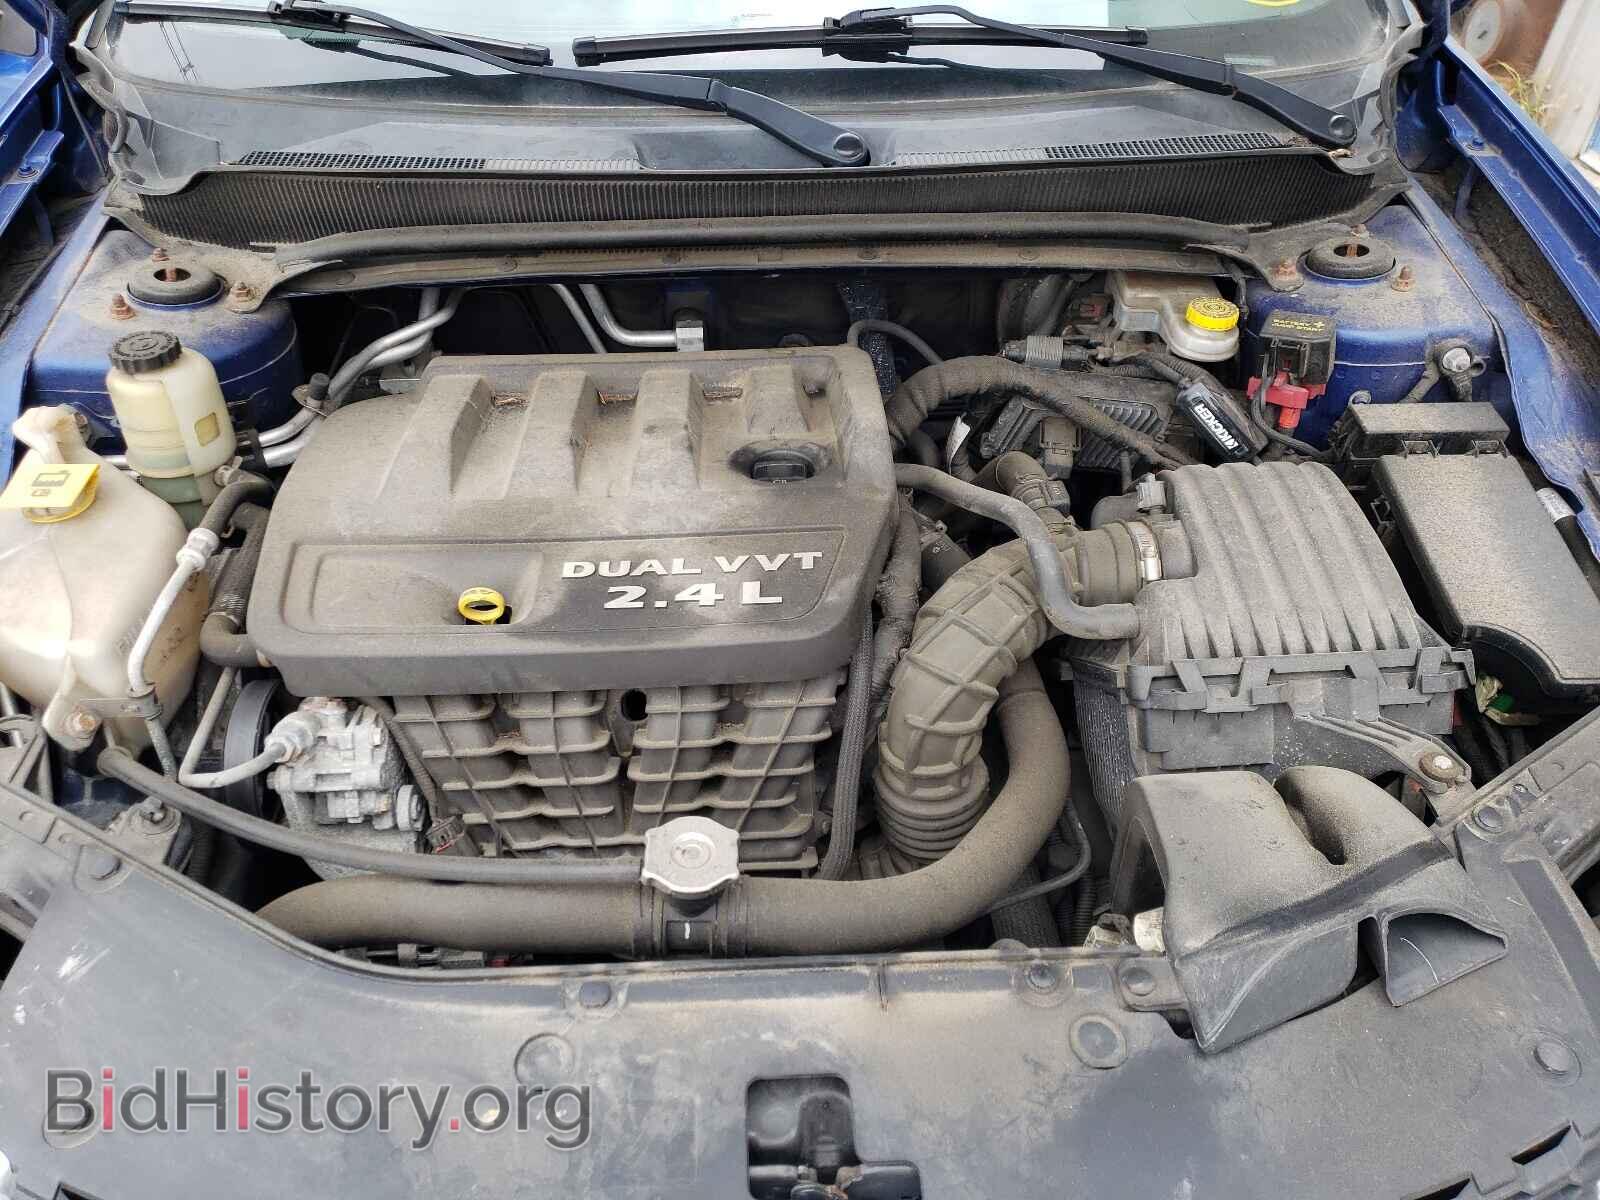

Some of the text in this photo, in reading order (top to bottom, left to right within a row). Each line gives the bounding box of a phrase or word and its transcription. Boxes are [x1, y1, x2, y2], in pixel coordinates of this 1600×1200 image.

[1194, 403, 1237, 449] KICKER
[561, 552, 823, 578] DUAL VVT
[741, 580, 783, 605] L
